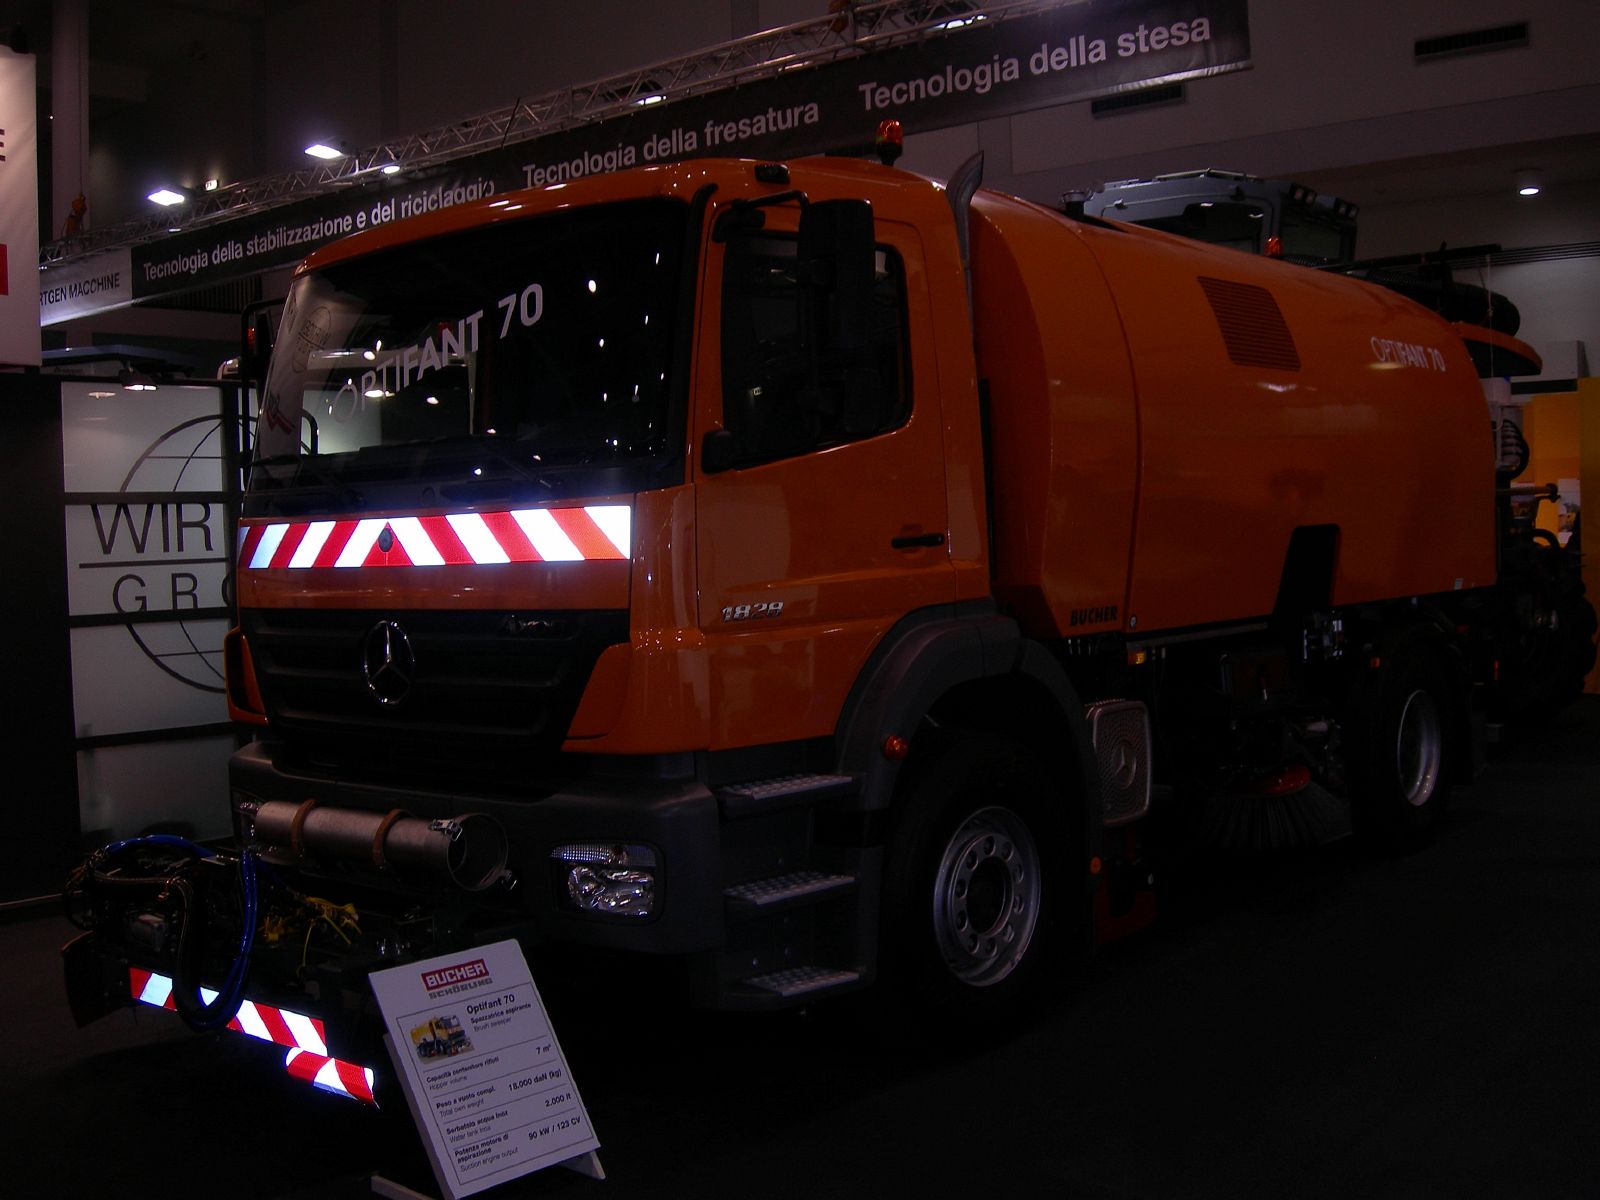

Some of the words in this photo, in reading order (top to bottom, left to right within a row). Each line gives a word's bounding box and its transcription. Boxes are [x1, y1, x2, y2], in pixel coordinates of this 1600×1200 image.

[858, 55, 1019, 111] Tecnologia
[1029, 34, 1106, 76] della
[1117, 16, 1211, 57] stesa
[522, 143, 636, 188] Tecnologia
[643, 128, 698, 161] della
[704, 102, 819, 147] fresatura
[144, 249, 209, 281] Tecnologia
[212, 240, 243, 265] della
[247, 216, 353, 256] stabilizzazione
[356, 211, 366, 227] e
[371, 199, 395, 226] del
[401, 177, 495, 219] riciclaggio
[69, 272, 120, 299] MACCHINE
[332, 310, 483, 423] OPTIFANT
[498, 282, 544, 340] 70
[1371, 336, 1429, 369] OPTIFANT
[1427, 347, 1446, 372] 70
[90, 502, 213, 554] WIR
[1071, 605, 1118, 626] BUCHER
[425, 962, 486, 987] BUCHER
[467, 998, 502, 1014] Optifant
[504, 994, 515, 1003] 70
[528, 1131, 537, 1140] 90
[557, 1120, 569, 1130] 123
